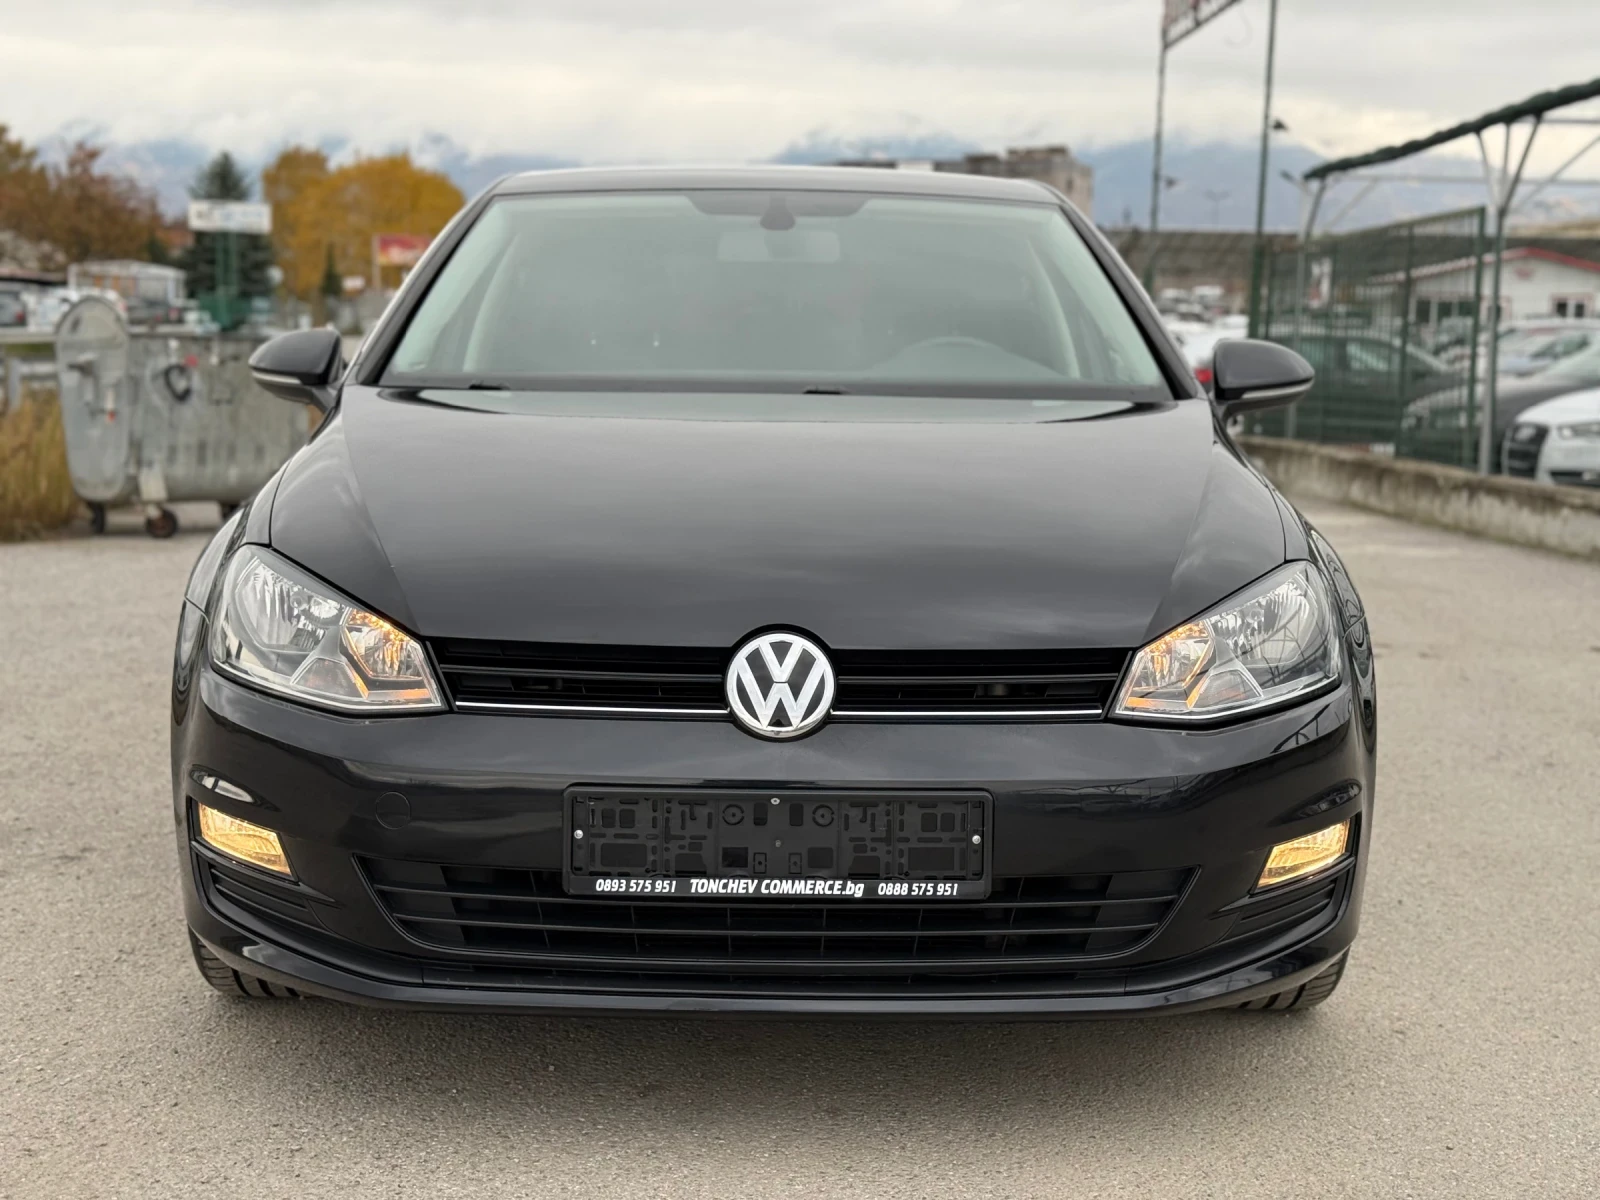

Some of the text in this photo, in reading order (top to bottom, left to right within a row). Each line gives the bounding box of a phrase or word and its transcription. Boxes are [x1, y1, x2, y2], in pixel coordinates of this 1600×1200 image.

[595, 878, 959, 898] 0893 575 951 TONCHEV COMMERCE.bg 0888 575 951
